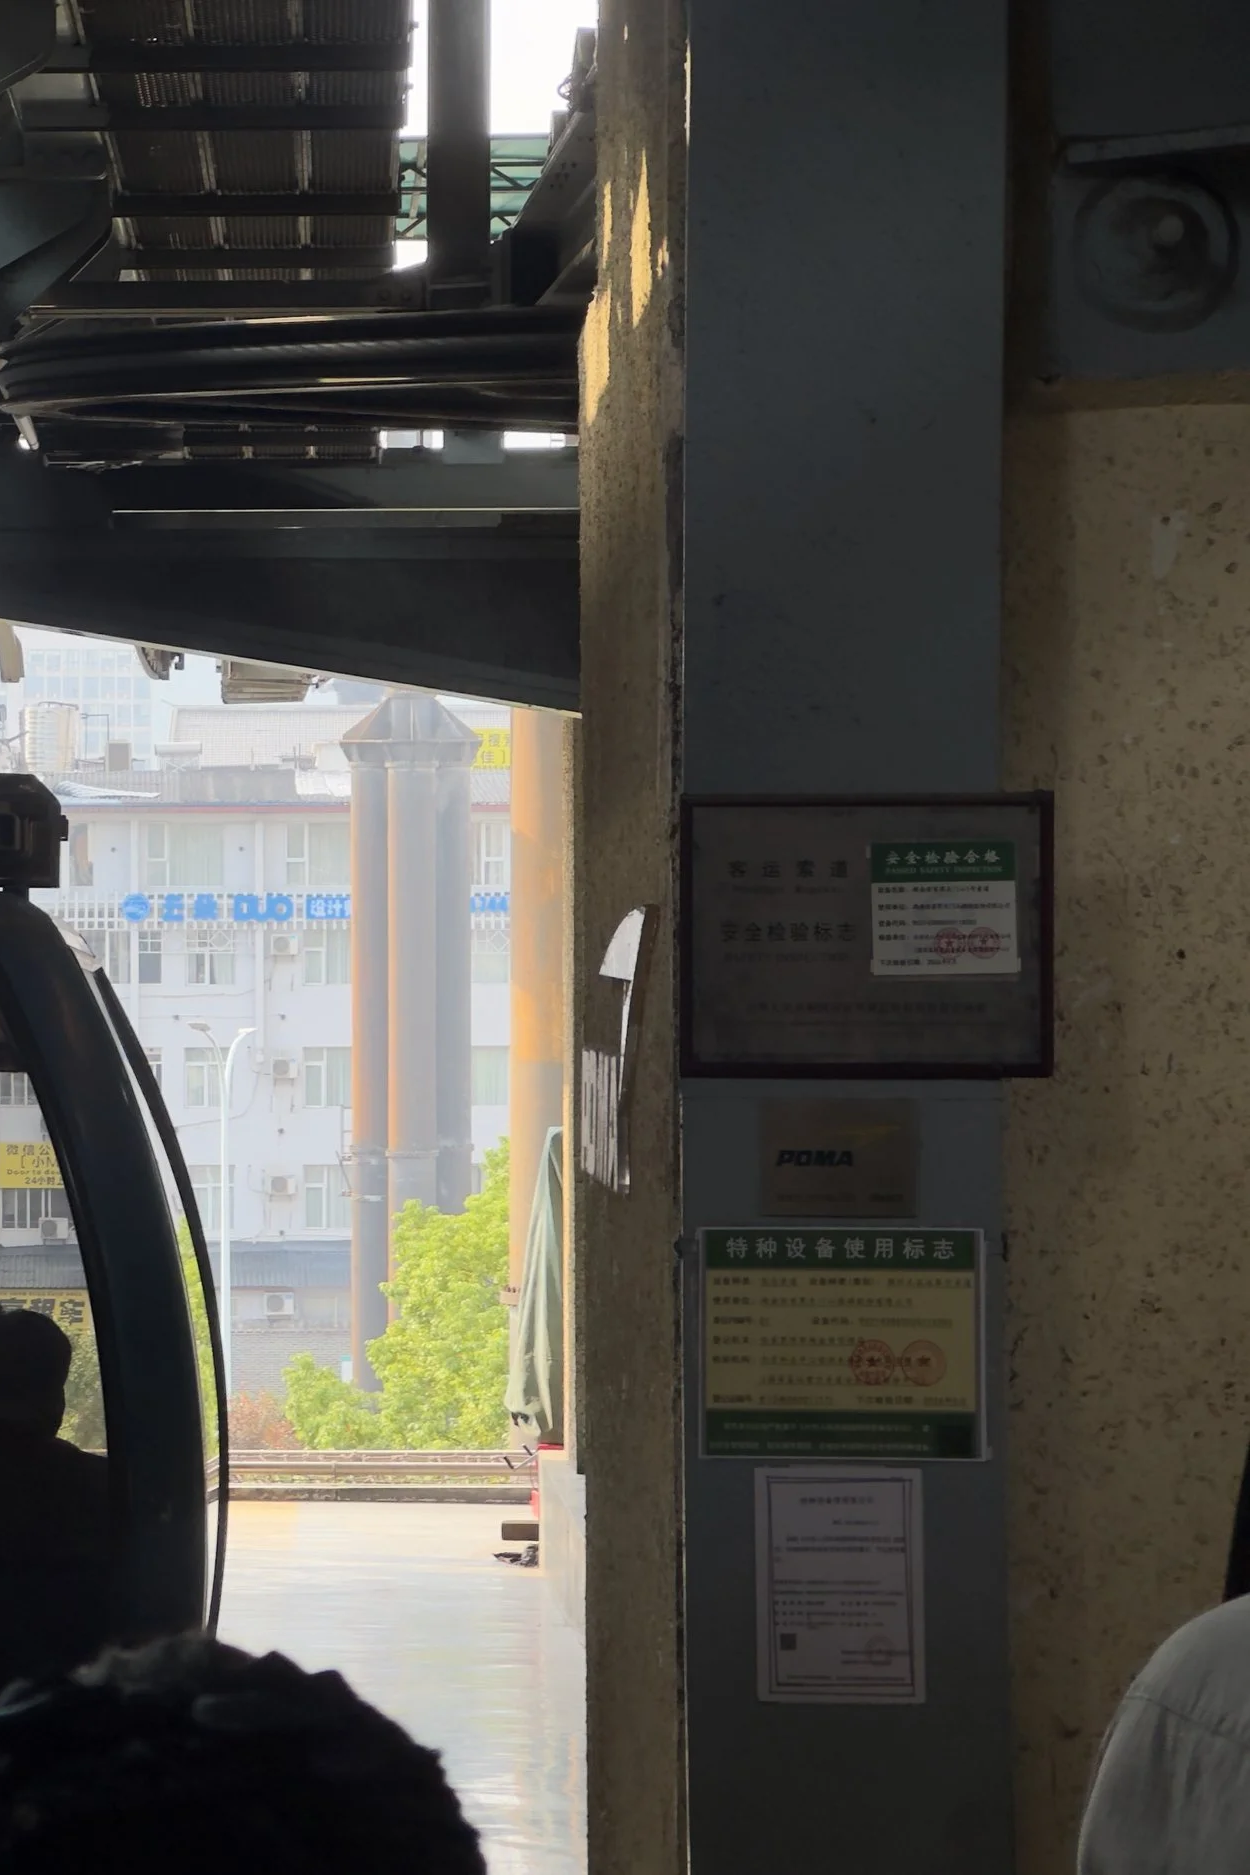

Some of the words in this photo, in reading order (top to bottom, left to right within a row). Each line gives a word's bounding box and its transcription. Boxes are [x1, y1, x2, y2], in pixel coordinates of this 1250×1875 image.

[885, 849, 1001, 864] 安全检验合格
[720, 920, 857, 942] 安全检验标志
[776, 1150, 854, 1166] POMA
[726, 1236, 956, 1260] 特种设备使用标志
